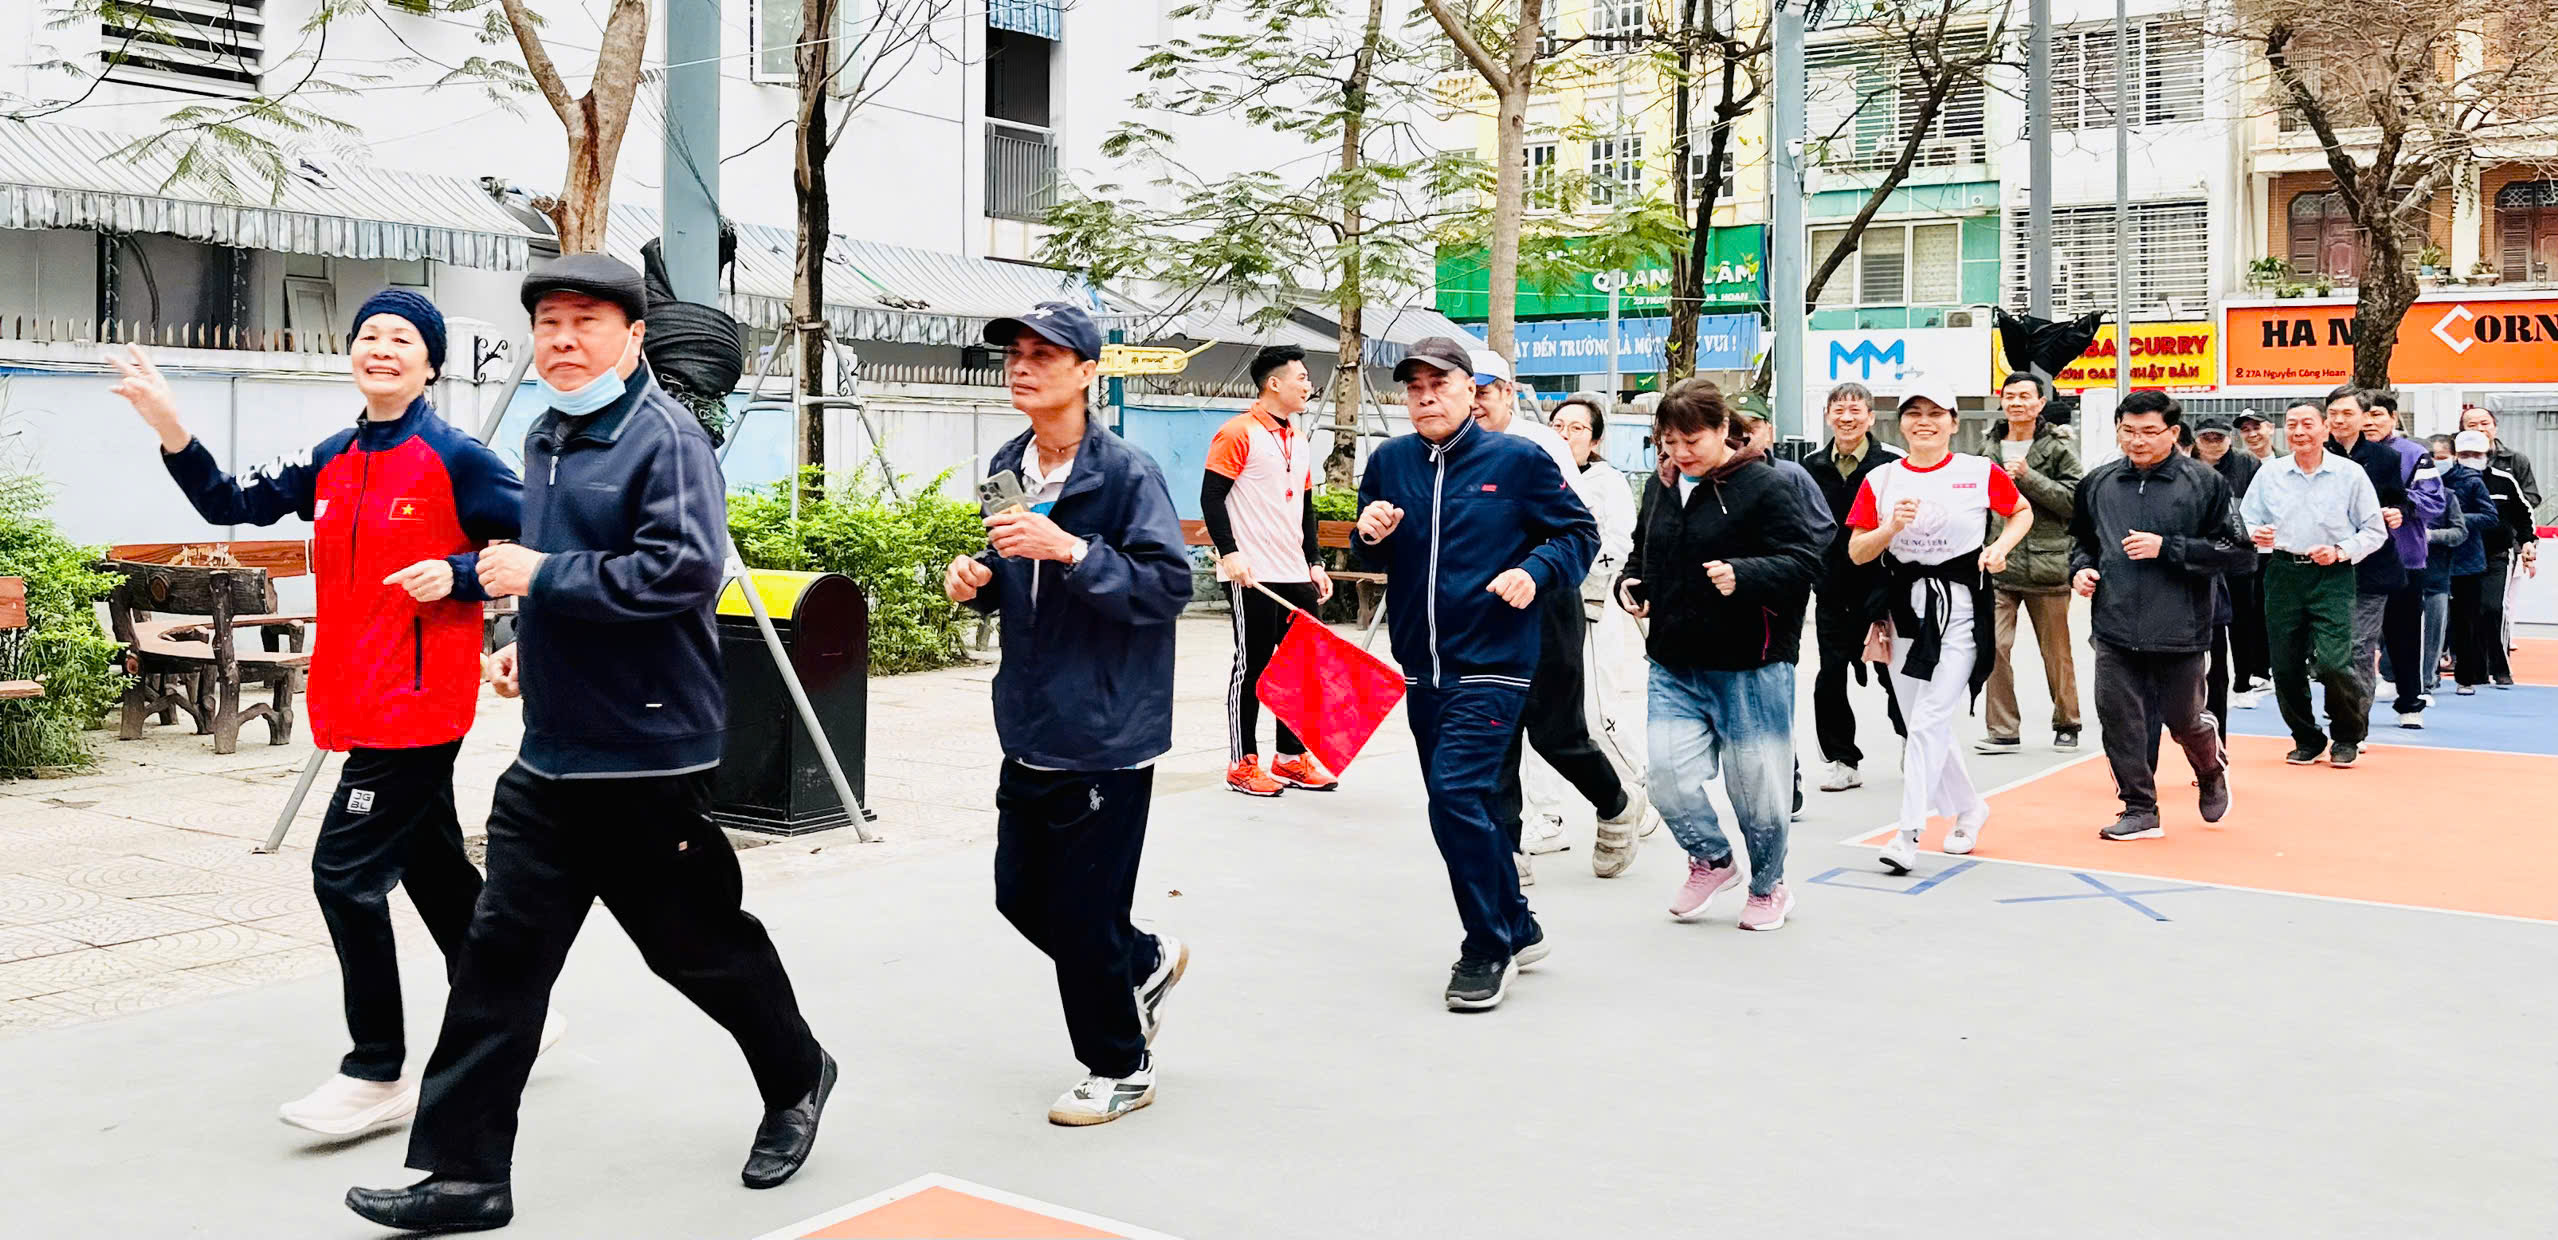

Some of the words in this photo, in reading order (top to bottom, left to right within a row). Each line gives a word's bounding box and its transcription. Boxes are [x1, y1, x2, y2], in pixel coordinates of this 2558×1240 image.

[1592, 268, 1673, 293] QUAN
[1533, 333, 1557, 358] ĐẾN
[1559, 333, 1610, 356] TRƯỜNG
[1616, 332, 1632, 356] LÀ
[1634, 332, 1662, 358] MỘT
[1704, 333, 1729, 353] VUI
[2082, 337, 2118, 357] BA
[2129, 334, 2208, 357] CURRY
[2262, 319, 2317, 348] HA
[1829, 338, 1905, 380] MM
[2168, 361, 2200, 379] BẢN
[2245, 368, 2261, 378] 27A
[2298, 368, 2321, 379] Công
[2322, 368, 2346, 378] Hoan
